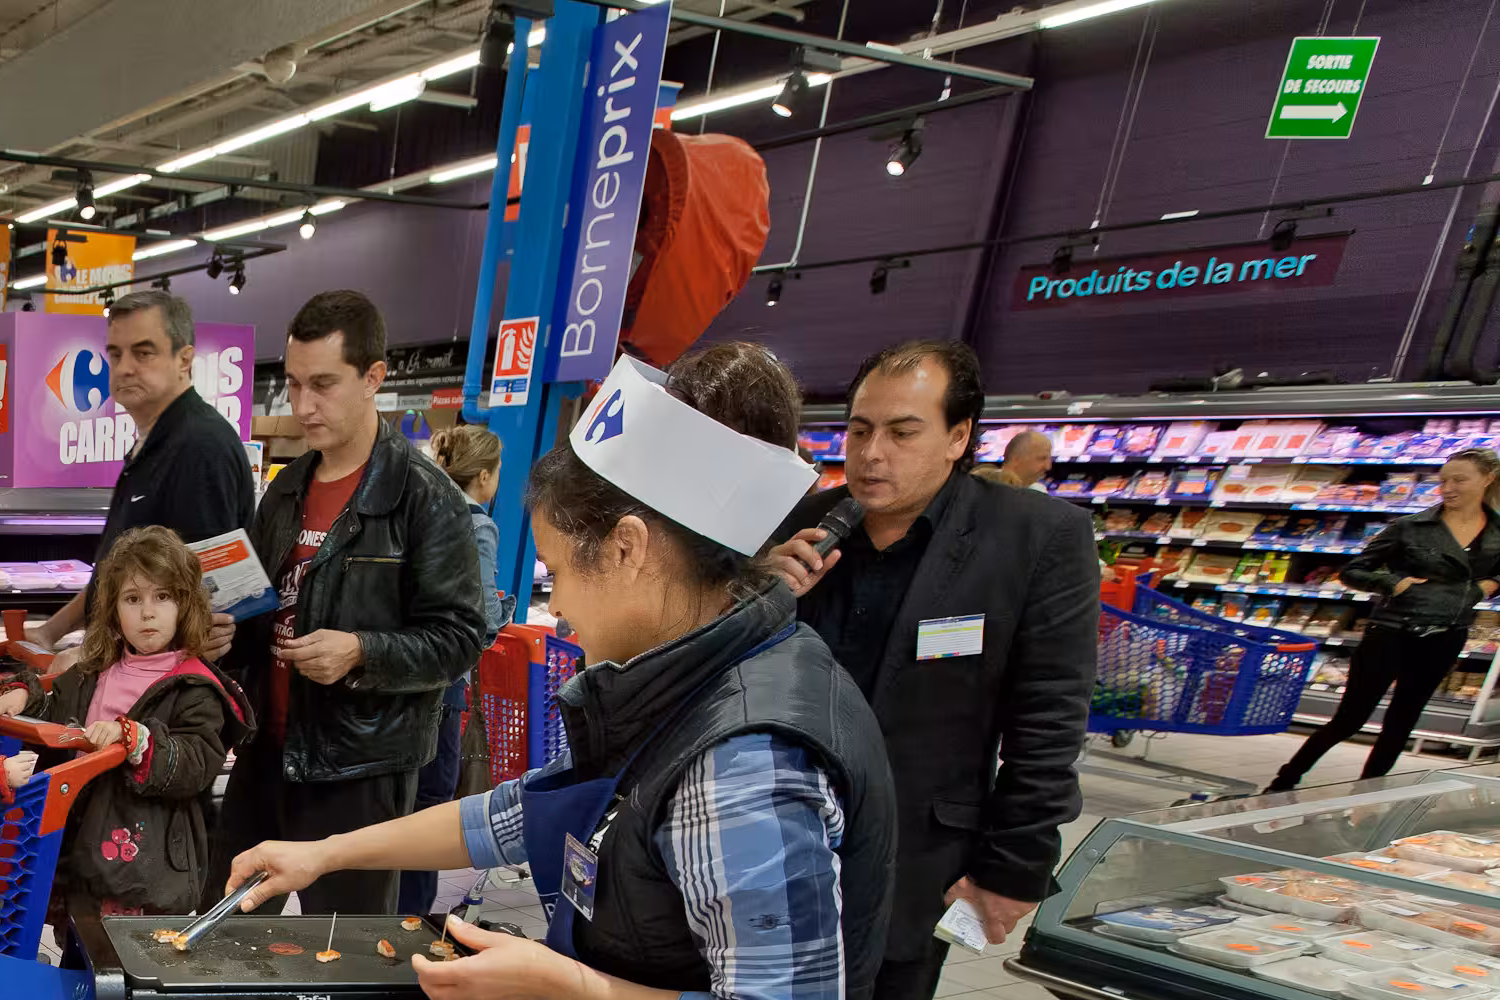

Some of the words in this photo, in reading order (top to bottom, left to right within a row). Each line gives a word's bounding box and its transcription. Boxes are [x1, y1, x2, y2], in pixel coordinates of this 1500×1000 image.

[1306, 54, 1355, 70] SORTIE
[1283, 78, 1302, 94] DE
[1303, 78, 1362, 94] SECOURS
[560, 32, 643, 359] Borneprix
[1026, 266, 1154, 301] Produits
[1156, 260, 1200, 290] de
[1203, 256, 1235, 285] la
[1238, 253, 1317, 282] mer
[433, 395, 451, 405] Pizzas
